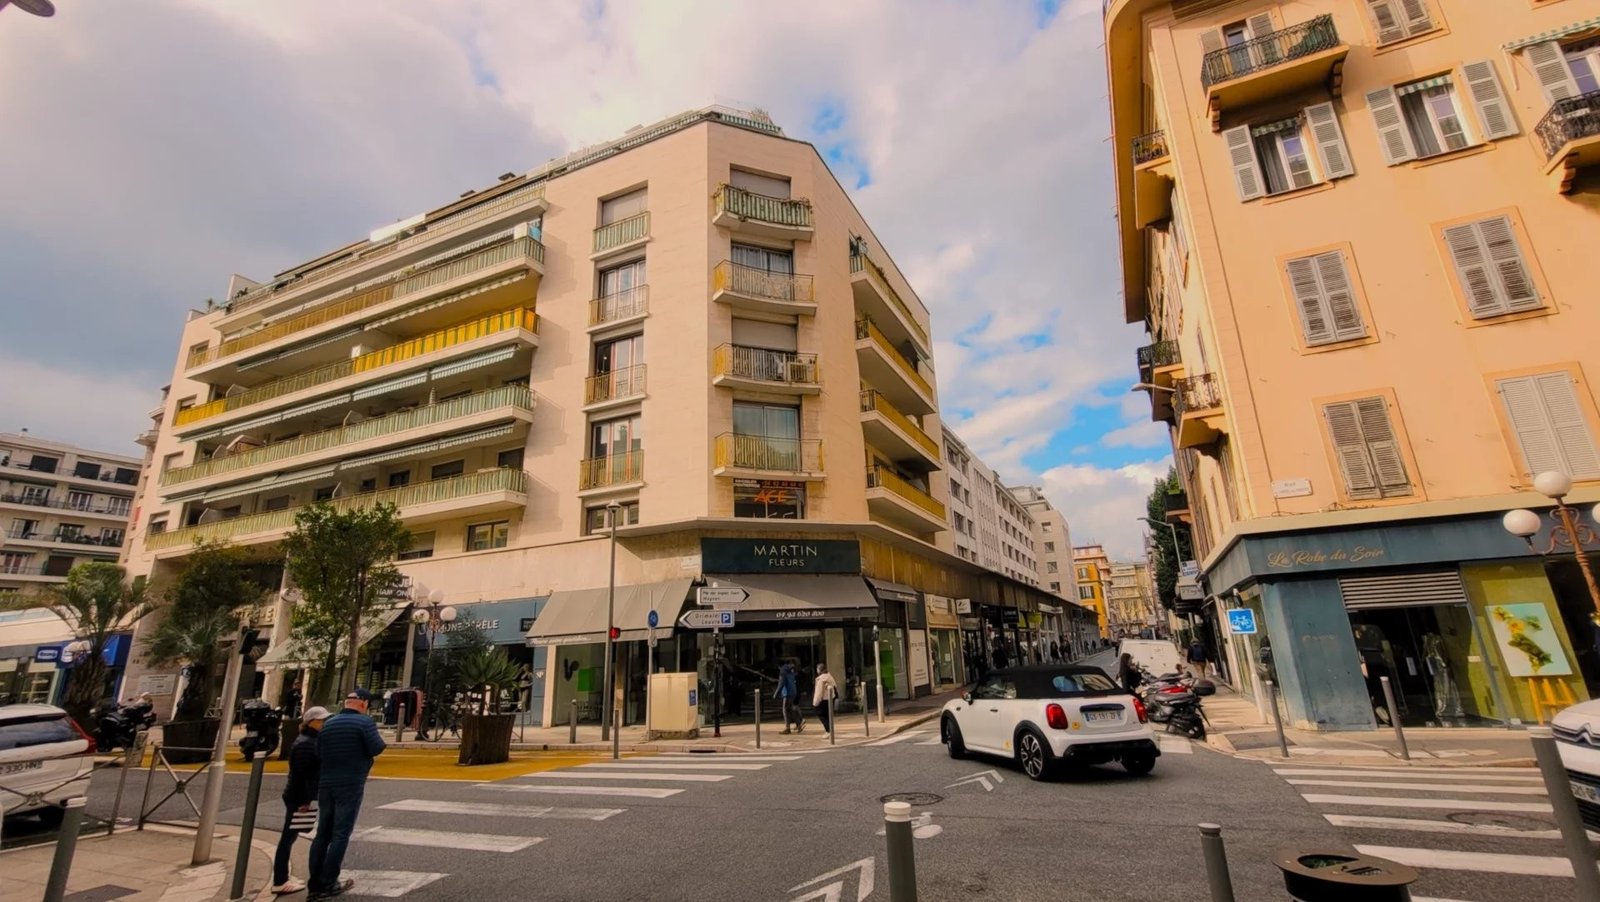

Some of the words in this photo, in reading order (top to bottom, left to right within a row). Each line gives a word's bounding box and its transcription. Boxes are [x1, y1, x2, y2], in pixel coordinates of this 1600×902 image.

[754, 545, 817, 556] MARTIN
[1268, 552, 1293, 567] La
[1330, 549, 1346, 560] du
[1350, 546, 1384, 562] Soir
[768, 558, 805, 567] FLEURS
